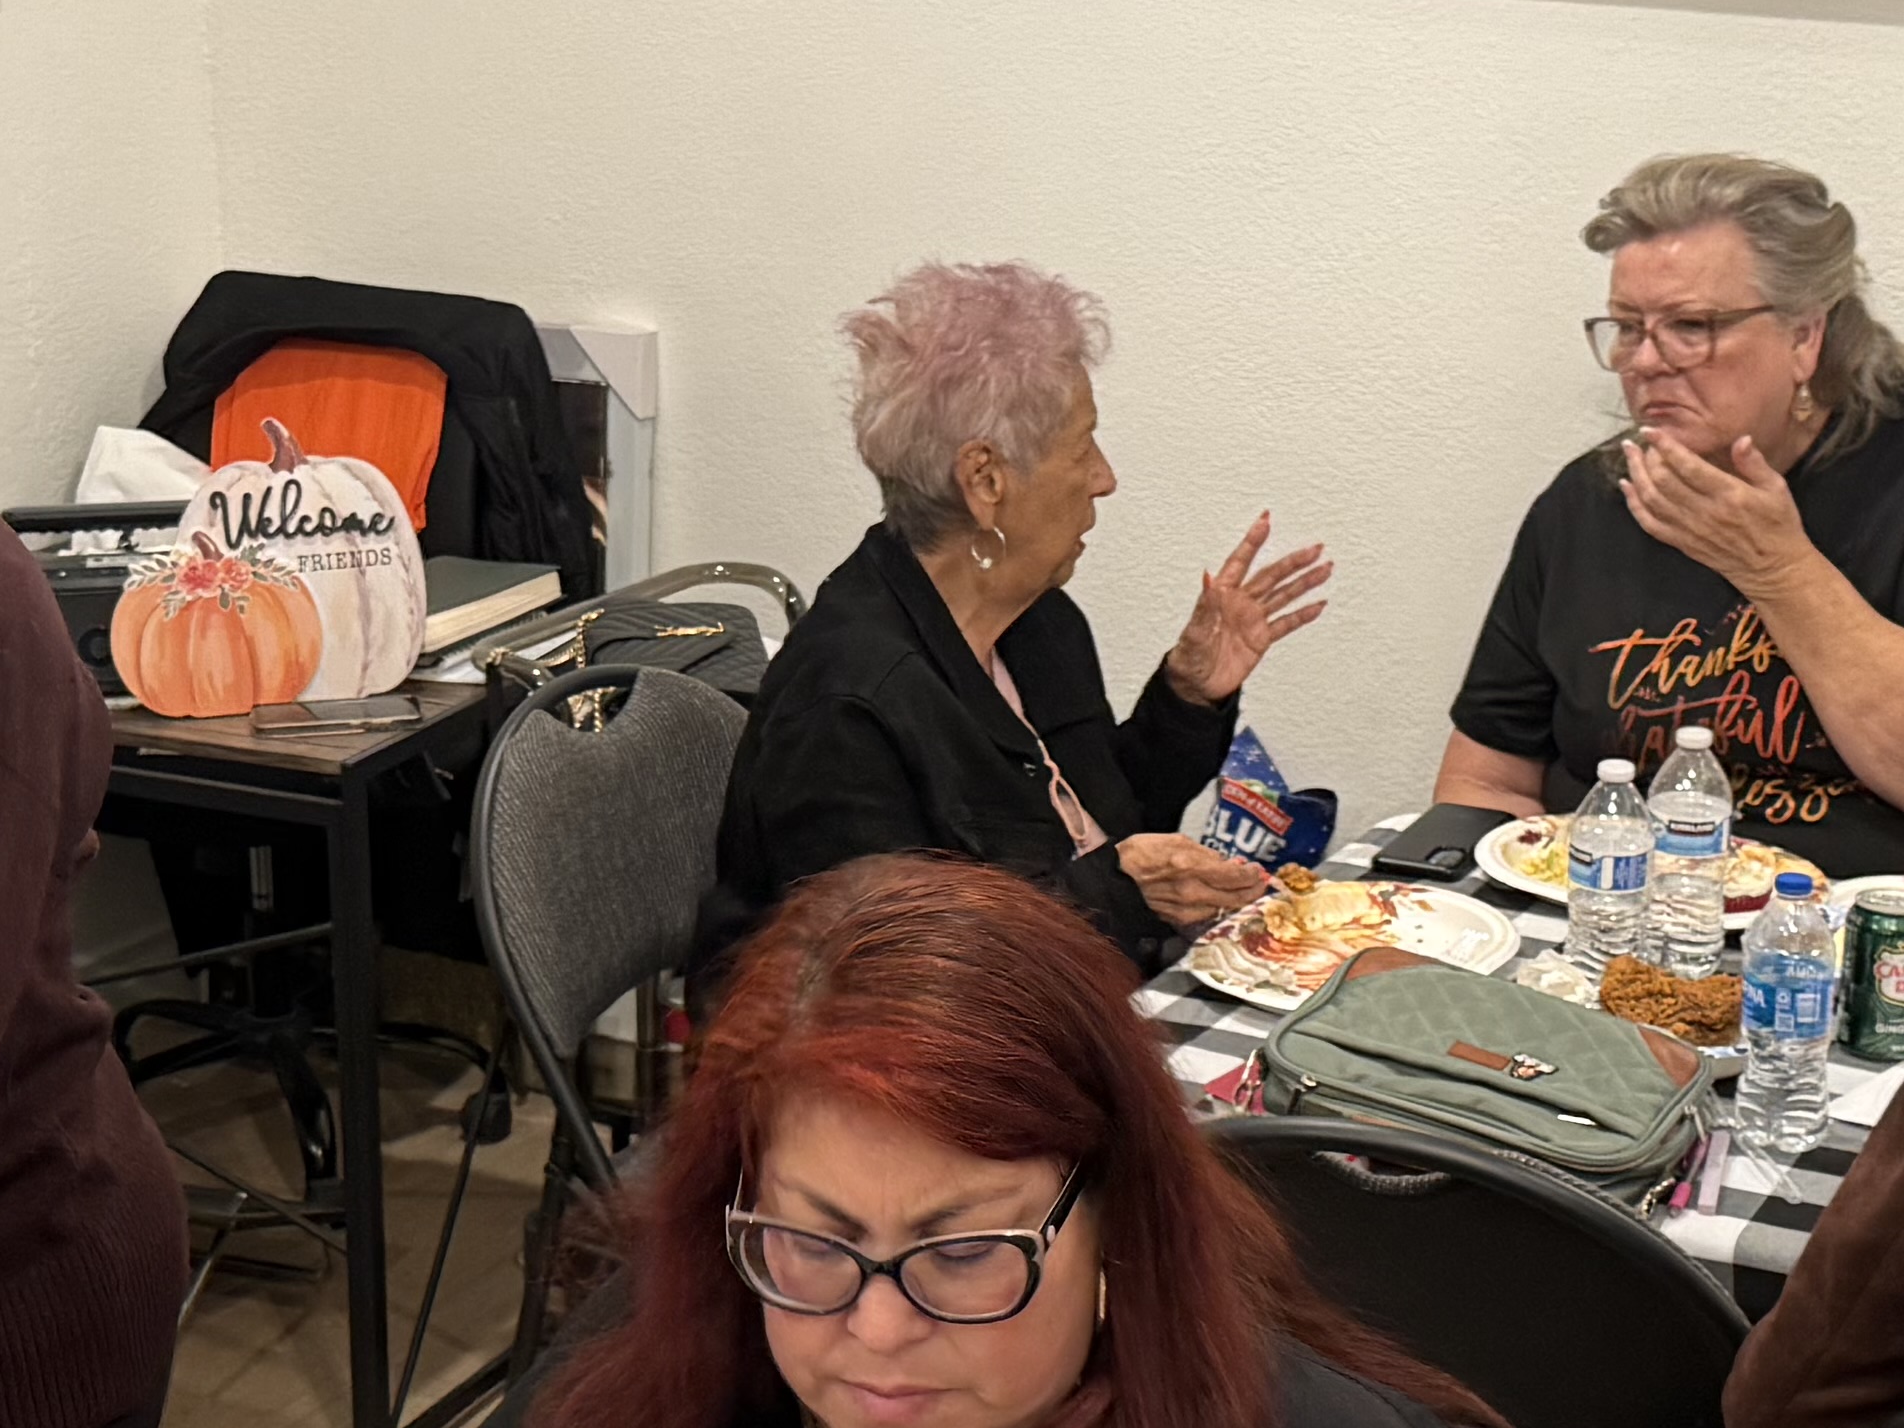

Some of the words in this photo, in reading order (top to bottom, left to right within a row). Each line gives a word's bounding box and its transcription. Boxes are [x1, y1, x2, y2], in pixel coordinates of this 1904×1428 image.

[209, 479, 394, 549] Welcome
[298, 547, 393, 573] FRIENDS
[1588, 610, 1777, 710] thankf
